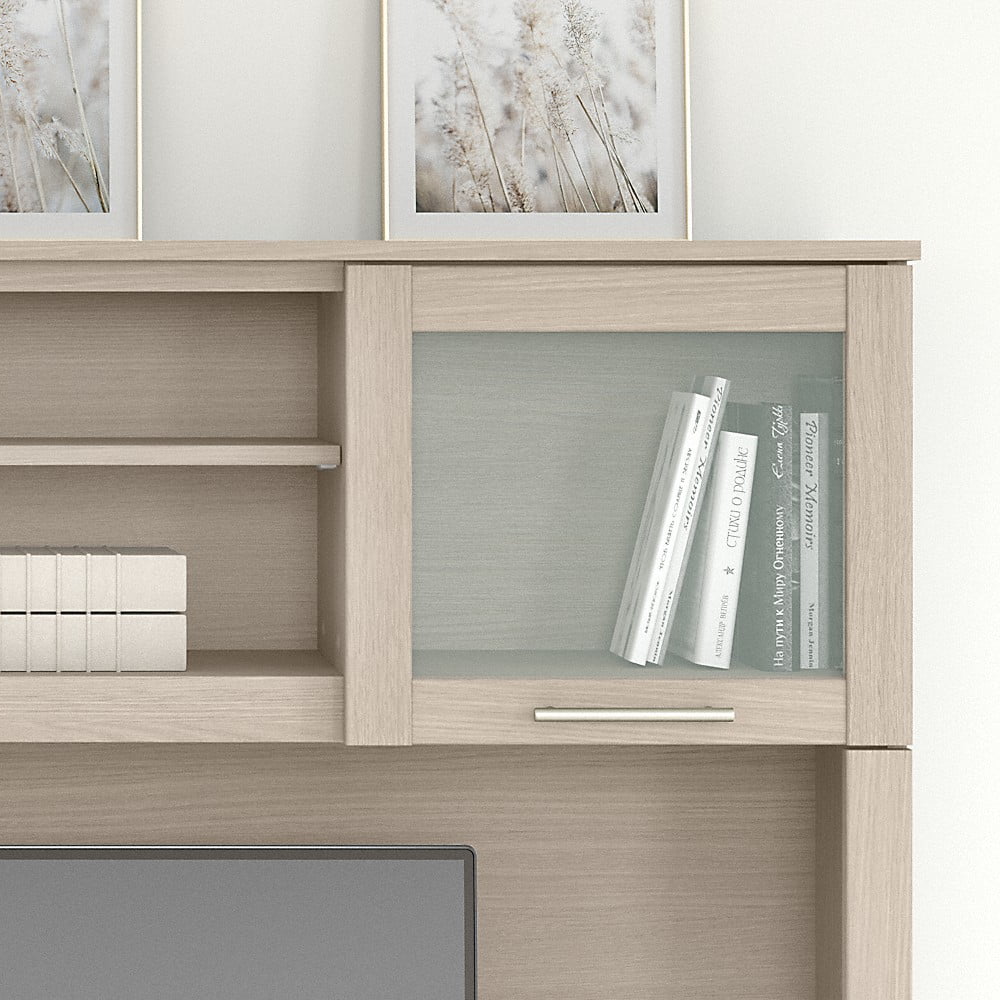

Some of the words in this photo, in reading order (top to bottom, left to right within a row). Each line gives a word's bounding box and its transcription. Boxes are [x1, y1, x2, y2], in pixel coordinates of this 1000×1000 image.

[804, 420, 818, 477] Pioneer
[683, 456, 707, 531] Memoirs
[804, 483, 818, 550] Memoirs
[773, 504, 785, 570] Огненному
[773, 574, 785, 605] Миру
[774, 619, 785, 647] пути
[807, 602, 816, 637] Morgan
[773, 651, 784, 666] На
